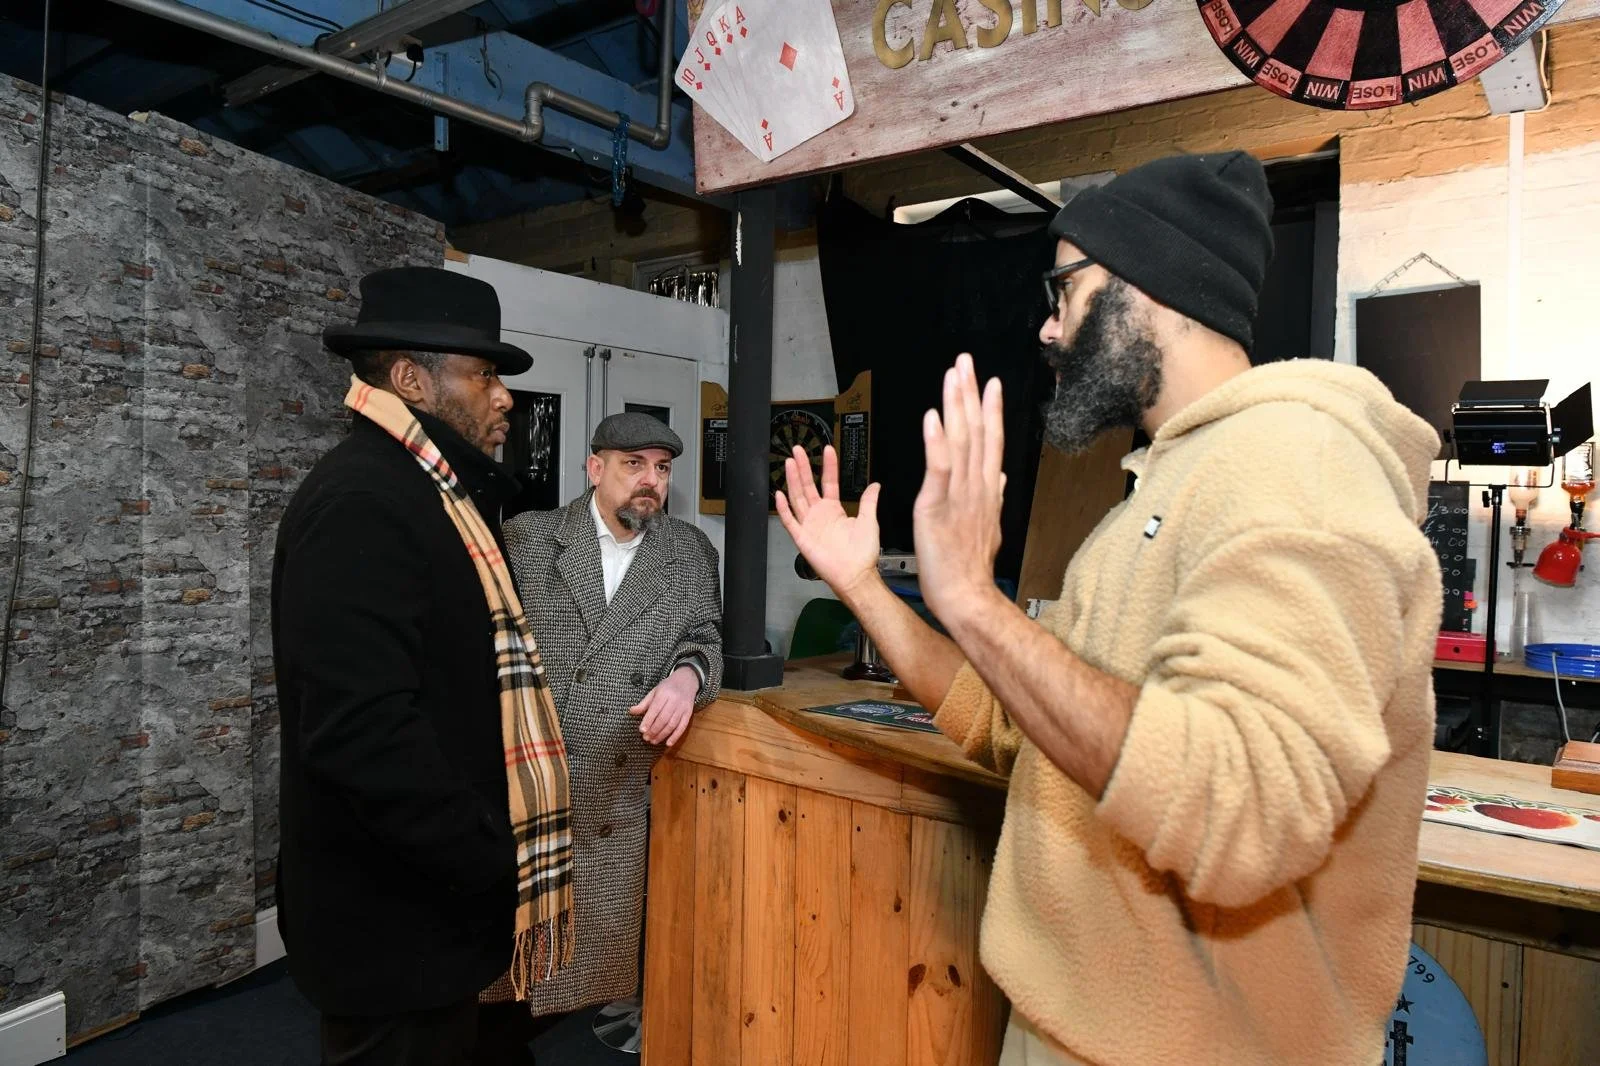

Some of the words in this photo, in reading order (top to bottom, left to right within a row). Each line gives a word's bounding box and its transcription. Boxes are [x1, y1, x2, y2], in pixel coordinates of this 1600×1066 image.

[1504, 2, 1543, 37] WIN
[681, 68, 696, 86] 10
[694, 47, 705, 65] J
[706, 31, 717, 47] Q
[718, 15, 731, 33] K
[735, 5, 746, 24] A
[871, 0, 1153, 69] CASI
[1233, 38, 1261, 69] WIN
[1452, 39, 1500, 72] LOSE
[1262, 61, 1297, 90] LOSE
[1407, 66, 1446, 92] WIN
[833, 90, 846, 112] A
[1305, 81, 1340, 100] WIN
[1352, 84, 1395, 100] LOSE
[762, 132, 773, 152] A
